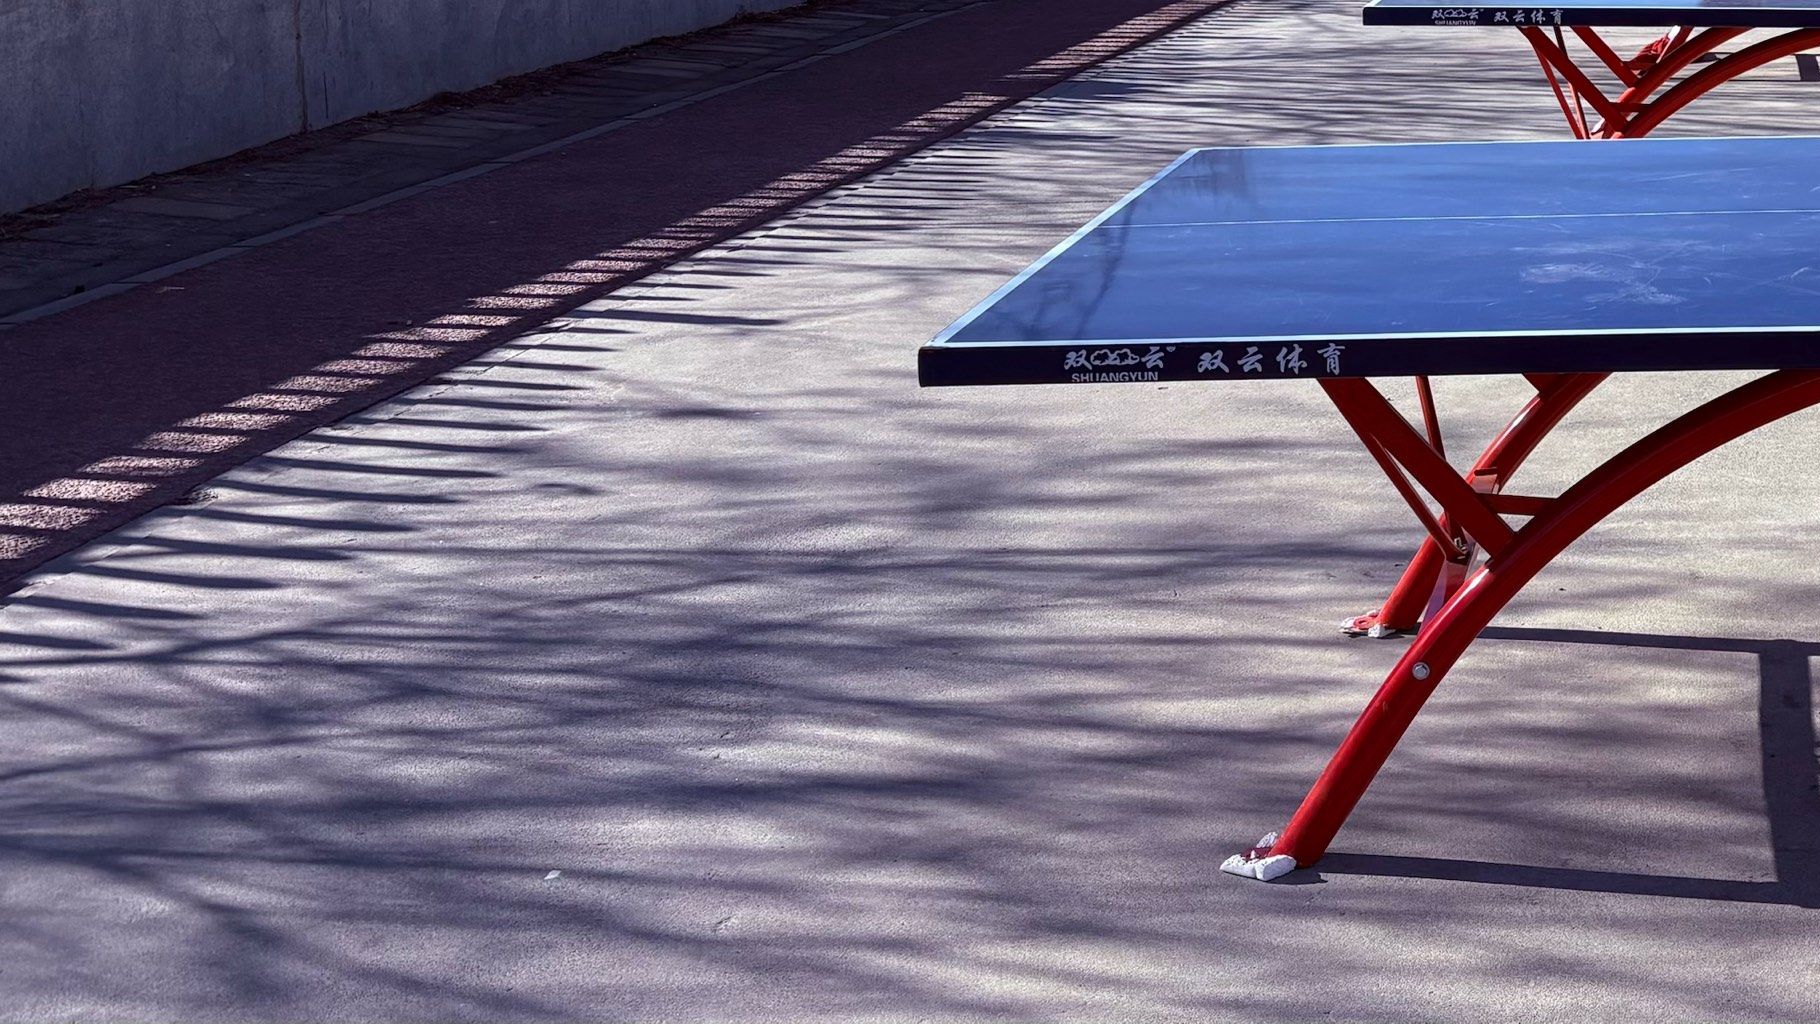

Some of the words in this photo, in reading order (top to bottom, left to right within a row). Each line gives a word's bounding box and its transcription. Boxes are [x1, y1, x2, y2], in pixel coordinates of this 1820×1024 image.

[1196, 342, 1346, 375] 双云体育
[1071, 371, 1159, 383] SHUANGYUN
